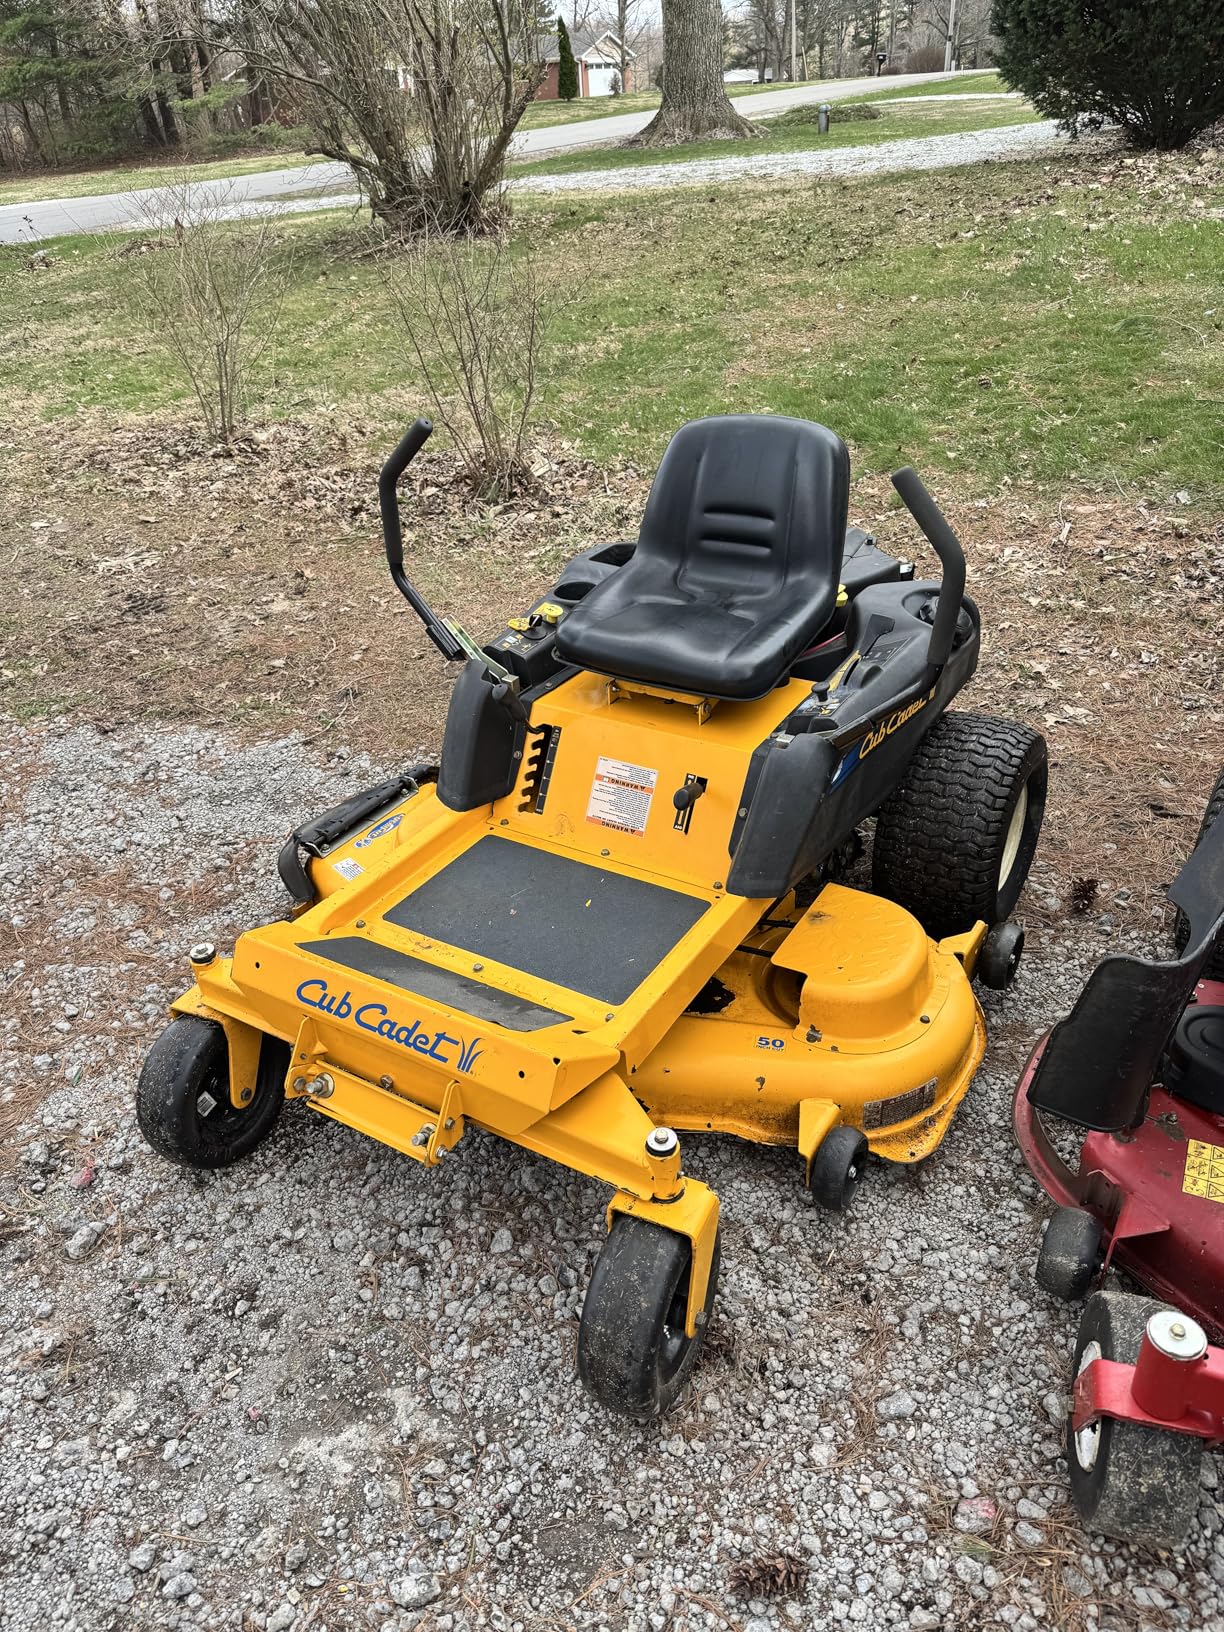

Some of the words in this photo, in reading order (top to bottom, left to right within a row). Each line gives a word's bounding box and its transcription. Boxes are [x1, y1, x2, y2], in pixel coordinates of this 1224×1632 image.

[859, 721, 885, 759] Cub
[611, 778, 639, 790] WARNING
[601, 820, 629, 832] WARNING
[296, 979, 352, 1019] Cub
[354, 1003, 460, 1063] Cadet
[757, 1037, 784, 1048] 50
